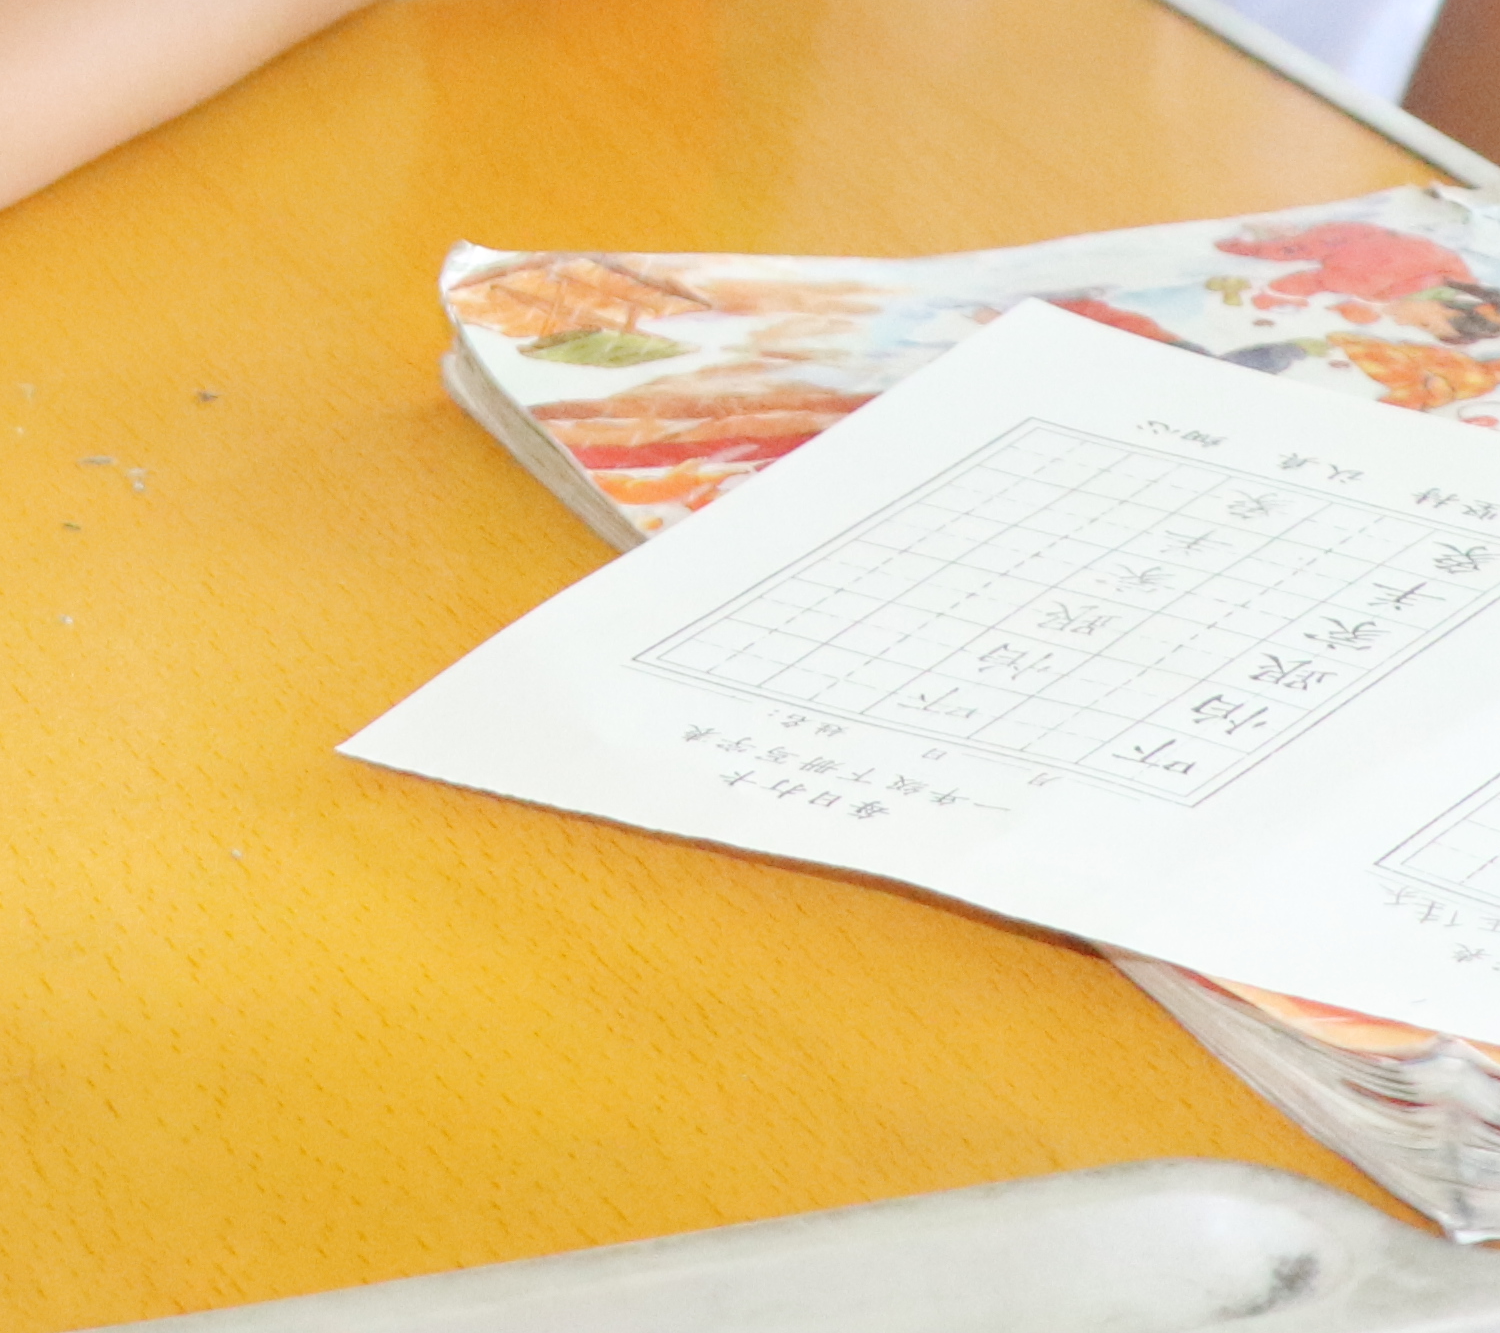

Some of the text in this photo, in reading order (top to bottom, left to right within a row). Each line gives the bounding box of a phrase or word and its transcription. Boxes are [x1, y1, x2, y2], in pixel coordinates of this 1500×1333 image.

[1136, 419, 1227, 448] 细心
[1273, 452, 1364, 484] 认真
[898, 686, 977, 720] 吓
[978, 643, 1052, 681] 怕
[1037, 602, 1121, 636] 跟
[1096, 564, 1176, 593] 家
[1111, 739, 1197, 776] 吓
[1190, 694, 1268, 735] 怕
[1249, 653, 1338, 691] 跟
[1303, 616, 1390, 651] 家
[1367, 583, 1445, 610] 羊
[681, 723, 1010, 811] 一年级下册写字表
[922, 748, 947, 761] 日
[719, 768, 890, 820] 每日打卡
